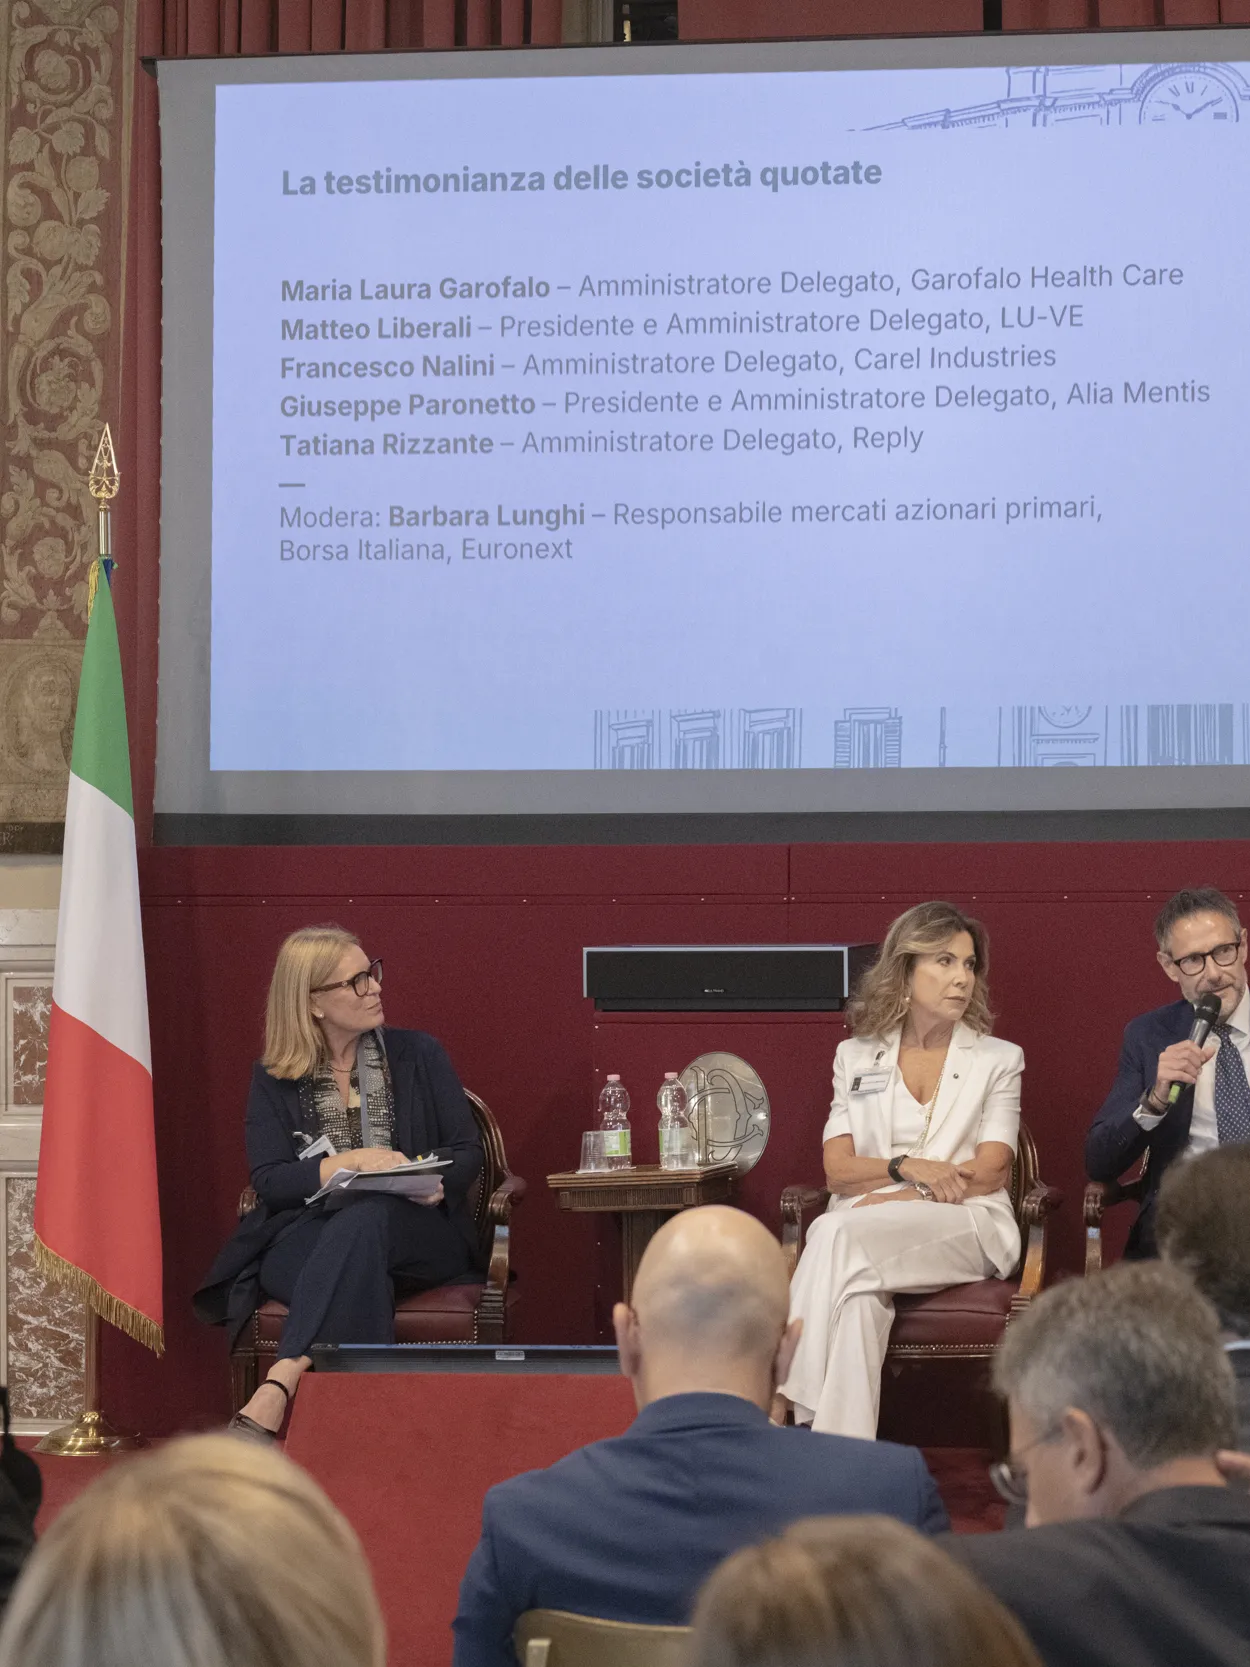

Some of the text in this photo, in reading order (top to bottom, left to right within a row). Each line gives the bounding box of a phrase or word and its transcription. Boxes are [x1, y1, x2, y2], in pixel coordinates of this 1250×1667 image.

[283, 160, 882, 195] La testimonianza delle società quotate
[282, 279, 351, 301] Maria
[361, 279, 431, 300] Laura
[440, 276, 550, 299] Garofalo
[579, 273, 771, 297] Amministratore
[781, 271, 900, 298] Delegato,
[912, 266, 1021, 290] Garofalo
[1032, 265, 1112, 288] Health
[1123, 264, 1183, 286] Care
[282, 319, 370, 340] Matteo
[378, 315, 471, 339] Liberali
[501, 314, 634, 337] Presidente
[644, 319, 657, 335] e
[666, 311, 860, 334] Amministratore
[870, 308, 989, 335] Delegato,
[1002, 305, 1083, 328] LU-VE
[281, 357, 414, 379] Francesco
[423, 354, 494, 377] Nalini
[523, 352, 715, 375] Amministratore
[725, 350, 843, 377] Delegato,
[855, 347, 920, 370] Carel
[931, 344, 1056, 368] Industries
[281, 395, 401, 422] Giuseppe
[410, 394, 535, 415] Paronetto
[565, 391, 698, 413] Presidente
[708, 395, 722, 411] e
[731, 387, 925, 411] Amministratore
[936, 385, 1056, 412] Delegato,
[1067, 382, 1113, 404] Alia
[1124, 380, 1210, 403] Mentis
[280, 433, 374, 456] Tatiana
[383, 432, 493, 454] Rizzante
[522, 430, 713, 453] Amministratore
[724, 428, 842, 455] Delegato,
[854, 426, 924, 453] Reply
[281, 506, 379, 528] Modera:
[390, 505, 489, 527] Barbara
[498, 503, 584, 531] Lunghi
[615, 501, 782, 529] Responsabile
[792, 499, 885, 522] mercati
[896, 497, 995, 521] azionari
[1006, 495, 1101, 525] primari,
[281, 538, 572, 564] Borsa Italiana, Euronext
